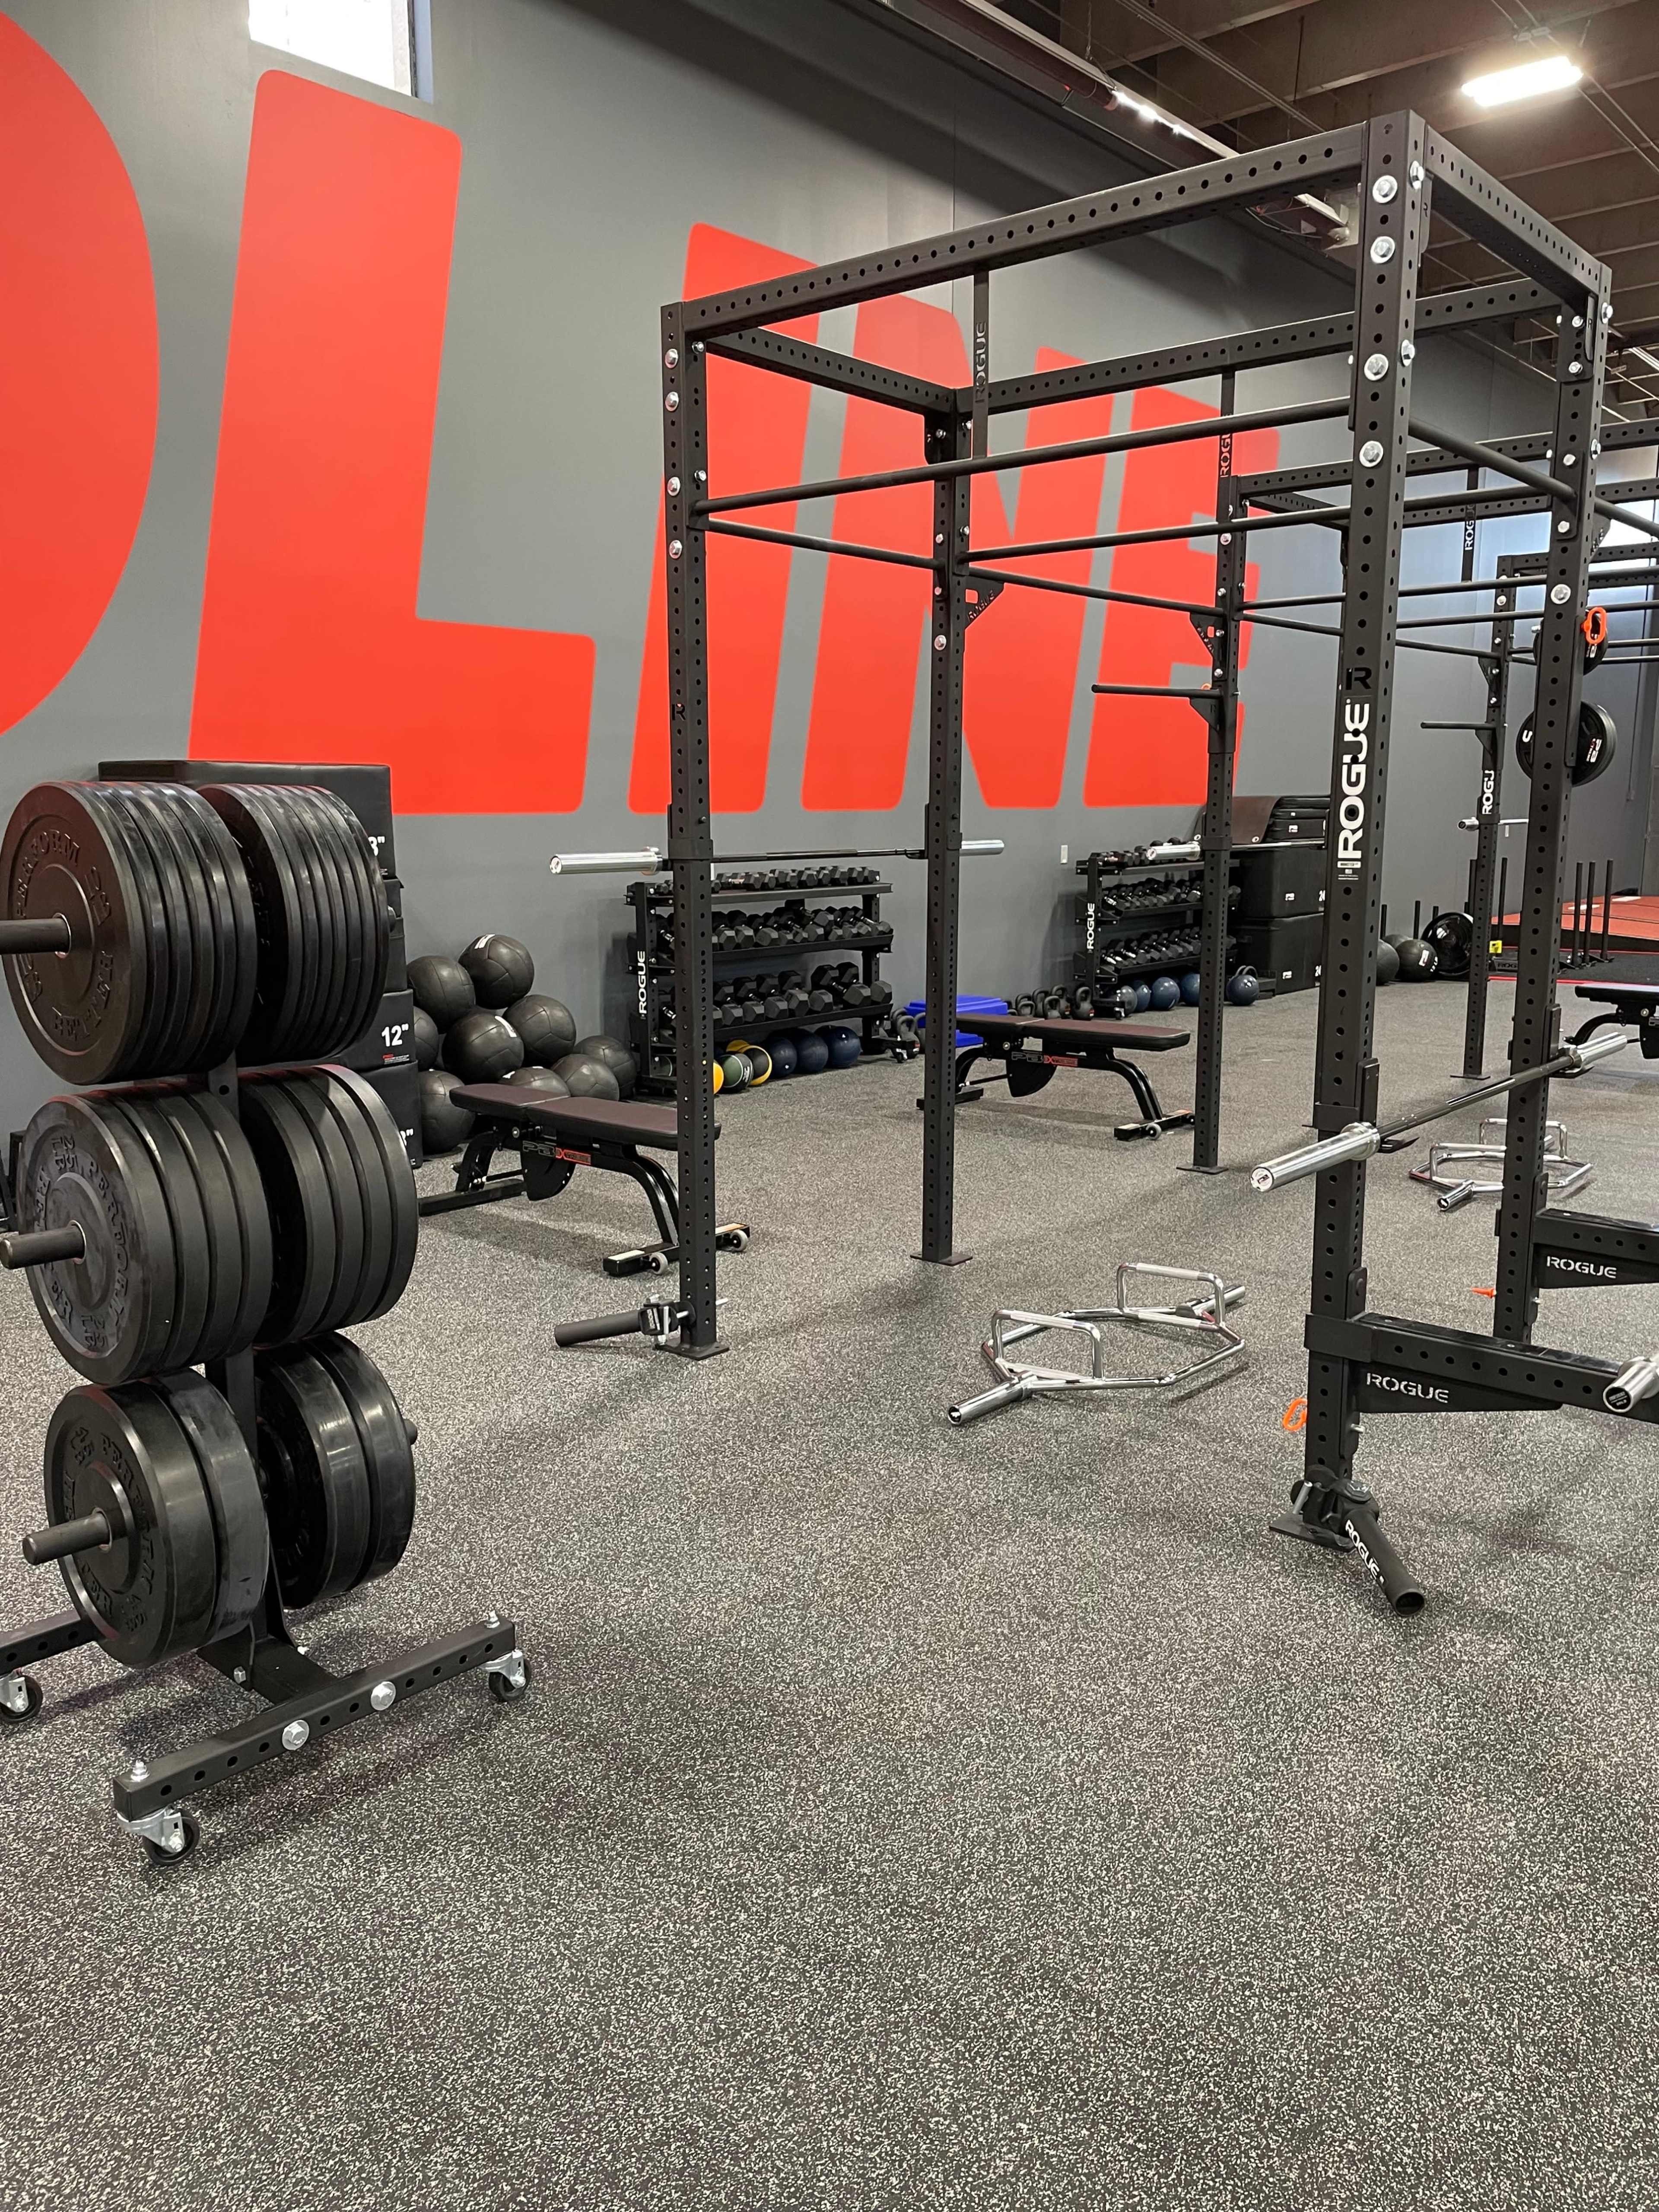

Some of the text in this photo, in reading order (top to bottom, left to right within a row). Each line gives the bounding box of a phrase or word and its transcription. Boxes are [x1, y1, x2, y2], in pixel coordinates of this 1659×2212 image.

[975, 321, 987, 403] ROGUE
[0, 11, 1280, 815] LINE
[1346, 667, 1372, 690] R
[672, 703, 686, 721] R
[1338, 703, 1370, 859] ROGUE
[1482, 770, 1494, 814] ROGU
[1087, 903, 1095, 950] ROGUE
[637, 950, 647, 1014] ROGUE
[381, 1023, 409, 1047] 12"
[1547, 1256, 1617, 1279] ROGUE
[1367, 1372, 1449, 1404] ROGUE
[1345, 1519, 1380, 1580] ROGUE
